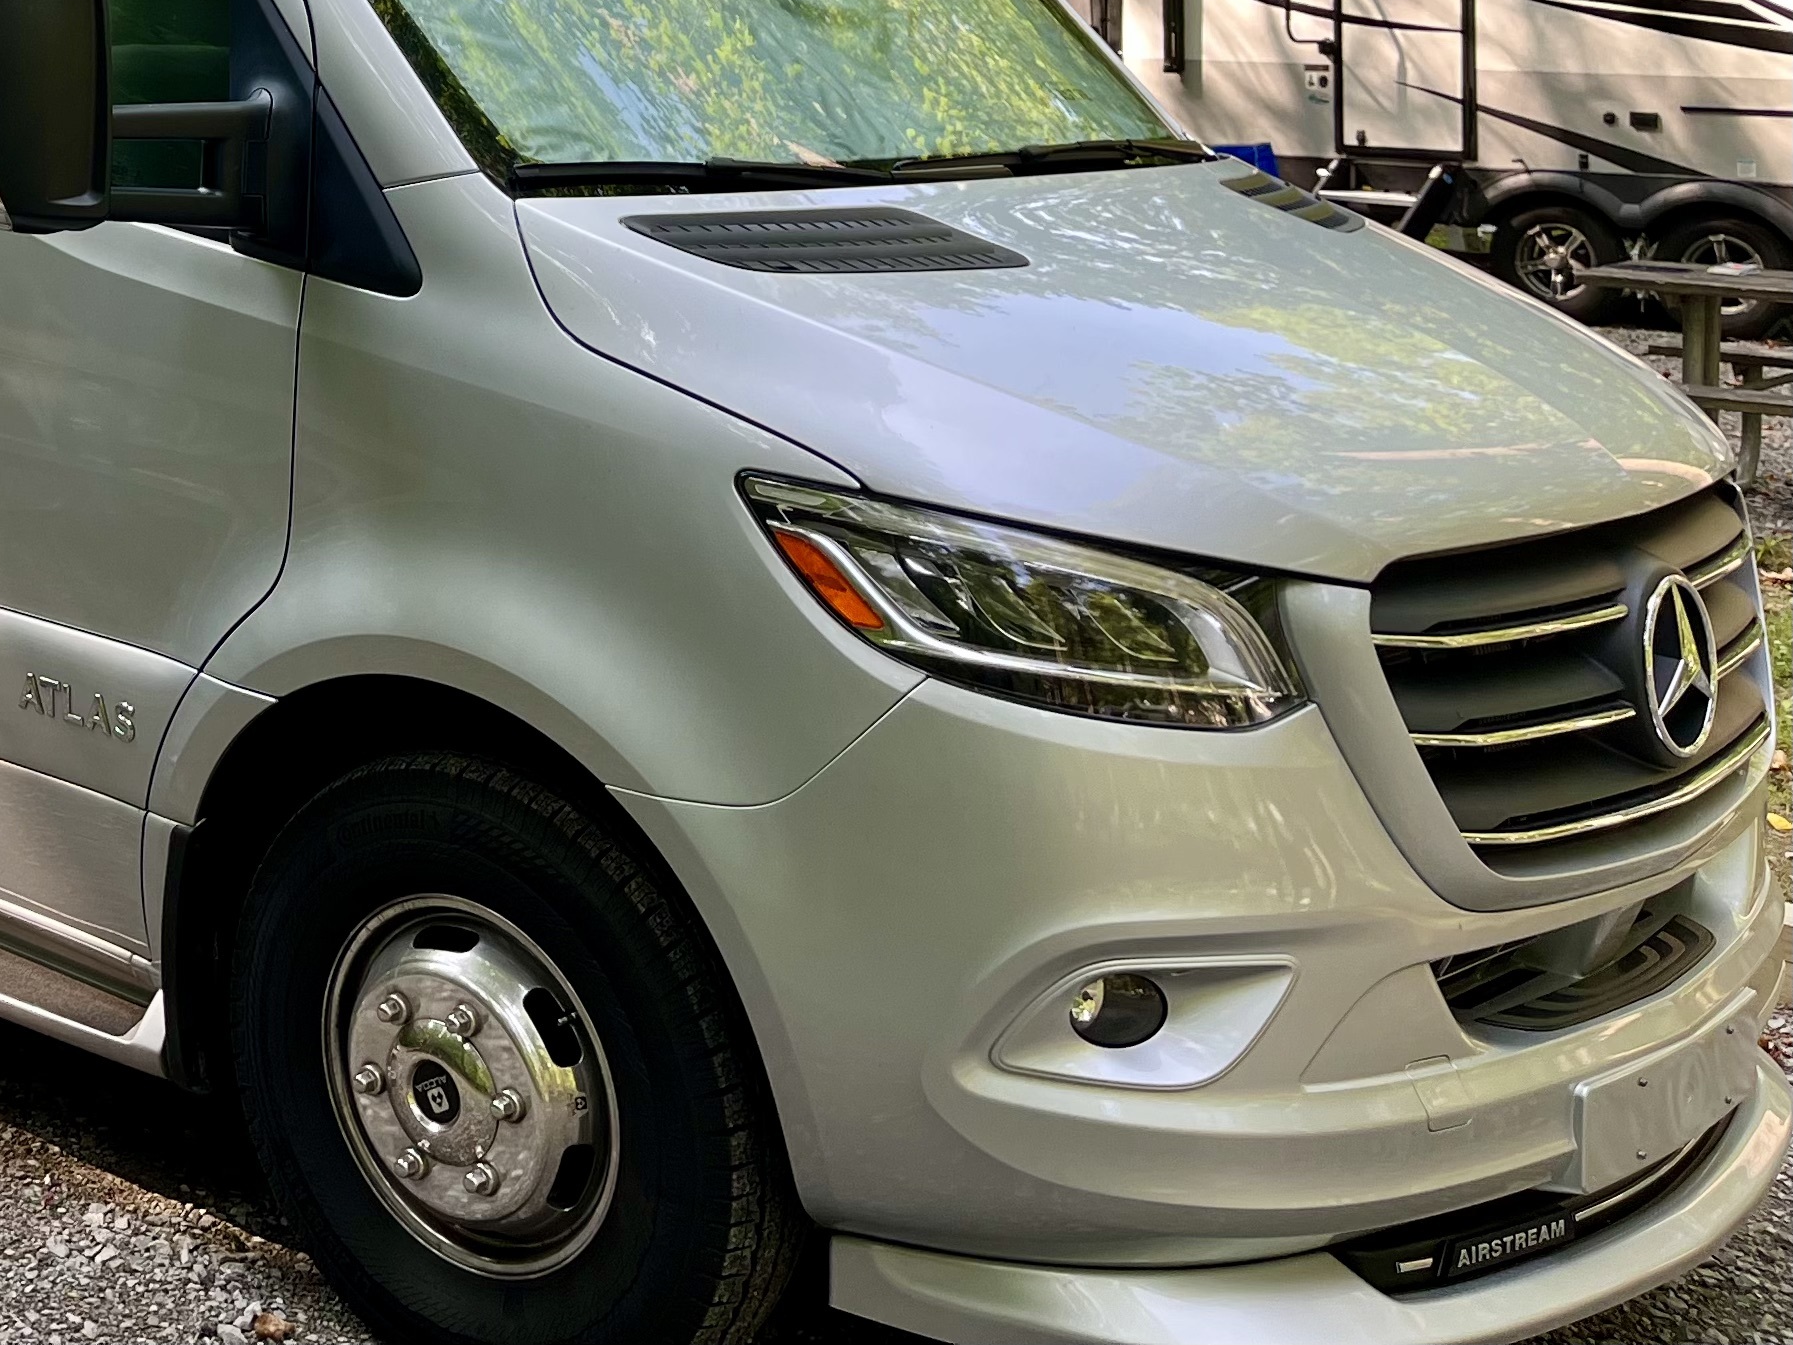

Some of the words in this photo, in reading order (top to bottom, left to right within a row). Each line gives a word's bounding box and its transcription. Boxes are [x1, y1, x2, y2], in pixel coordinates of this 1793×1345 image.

[18, 672, 136, 744] ATLAS
[414, 1074, 447, 1093] ALCOA
[1457, 1219, 1565, 1268] AIRSTREAM
